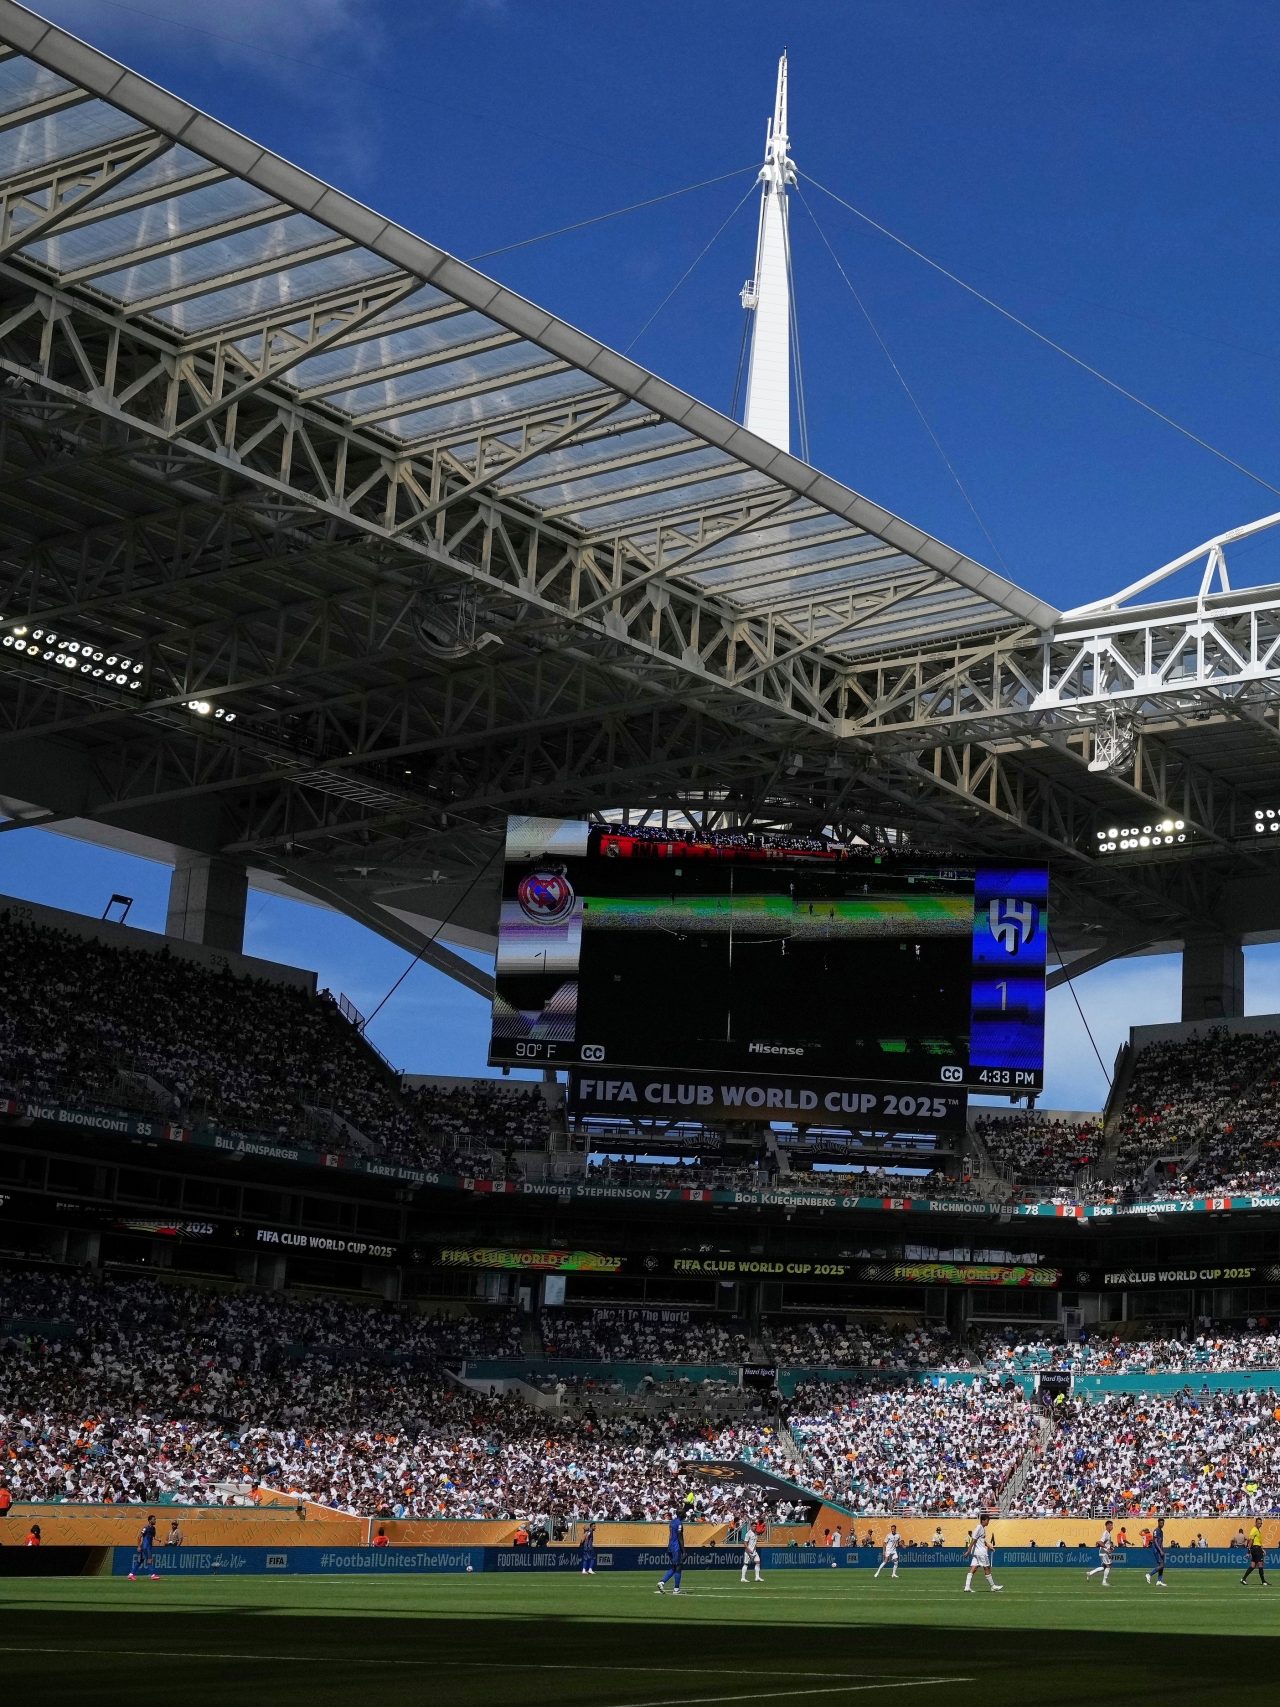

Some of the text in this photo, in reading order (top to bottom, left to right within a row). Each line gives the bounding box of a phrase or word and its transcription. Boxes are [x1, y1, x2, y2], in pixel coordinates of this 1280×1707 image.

[995, 981, 1007, 1011] 1
[547, 1044, 557, 1059] F
[583, 1047, 604, 1059] CC
[749, 1042, 804, 1056] Hisense
[942, 1067, 961, 1080] CC
[979, 1069, 1035, 1085] 4:33 PM
[580, 1079, 638, 1101] FIFA
[644, 1083, 714, 1105] CLUB
[720, 1086, 818, 1110] WORLD
[824, 1091, 877, 1113] CUP
[27, 1104, 152, 1136] NICK BUONICONTI 85
[1021, 1110, 1042, 1120] 327
[215, 1136, 299, 1161] BILL ARNSPARGER
[366, 1162, 439, 1184] LARRY LITTLE 66
[524, 1183, 672, 1200] DWIGHT STEPHENSON 57
[735, 1193, 859, 1208] BOB KUECHENBERG 67
[1251, 1196, 1280, 1208] DOUG
[929, 1201, 1039, 1216] RICHMOND WEBB 78
[1093, 1201, 1194, 1217] BOB BAUMHOWER 73
[257, 1229, 279, 1244] FIFA
[281, 1232, 307, 1247] CLUB
[309, 1236, 346, 1252] WORLD
[347, 1242, 367, 1255] CUP
[441, 1250, 470, 1263] FIFA
[673, 1258, 701, 1271] FIFA
[703, 1260, 736, 1272] CLUB
[738, 1261, 783, 1273] WORLD
[786, 1263, 813, 1275] CUP
[1104, 1272, 1127, 1285] FIFA
[1129, 1271, 1156, 1284] CLUB
[1158, 1269, 1198, 1283] WORLD
[1199, 1268, 1222, 1281] CUP
[641, 1309, 659, 1322] The
[760, 1368, 775, 1377] Rock
[1056, 1375, 1070, 1383] Rock
[180, 1553, 212, 1569] UNITES
[269, 1557, 284, 1565] FIFA
[320, 1553, 471, 1568] #FootballUnitesTheWorld
[497, 1553, 556, 1567] FOOTBALL UNITES
[771, 1552, 816, 1564] FOOTBALL UNITES
[1003, 1552, 1063, 1563] FOOTBALL UNITES
